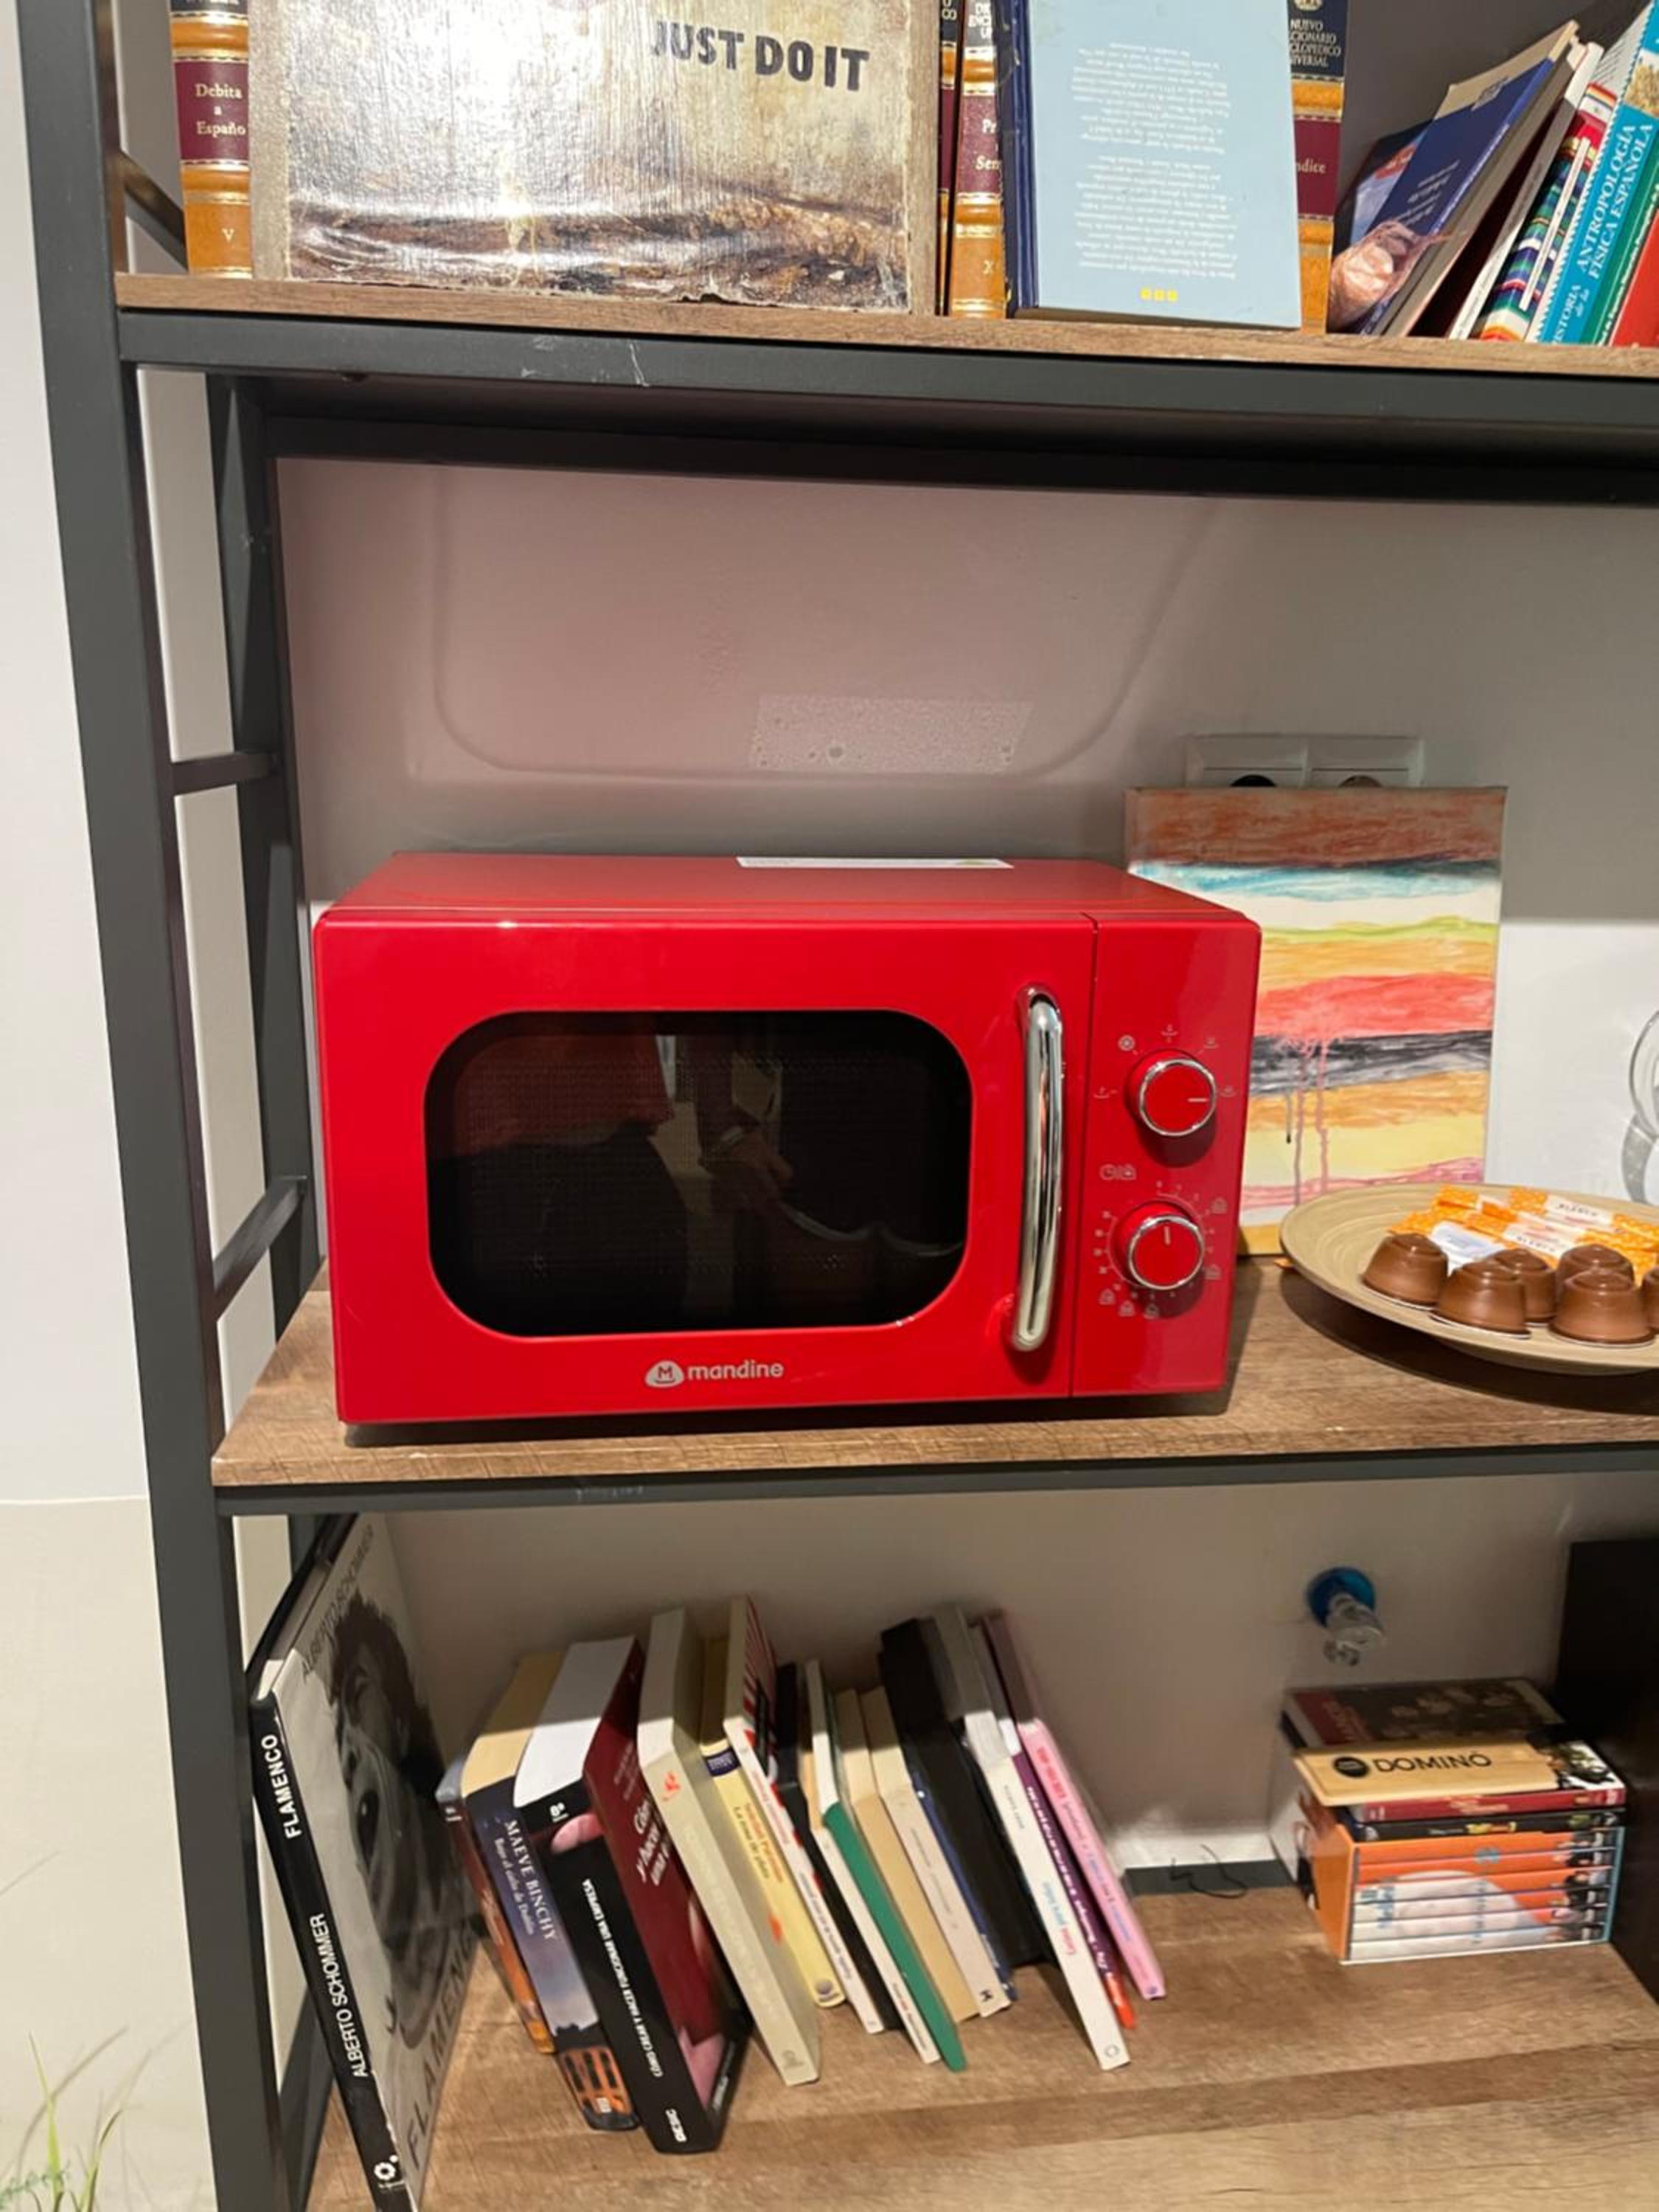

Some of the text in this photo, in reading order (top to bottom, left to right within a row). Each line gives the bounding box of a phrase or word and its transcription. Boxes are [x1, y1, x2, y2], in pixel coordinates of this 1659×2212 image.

[652, 21, 870, 91] JUST DO IT
[195, 83, 243, 100] Debita
[214, 105, 223, 116] a
[1576, 125, 1635, 273] ANTROPOLOGÍA
[1587, 220, 1618, 279] FÍSICA
[1610, 123, 1653, 219] ESPAÑOLA
[222, 228, 234, 243] V
[1553, 284, 1582, 345] ISTORIA
[687, 1359, 785, 1380] mandine
[261, 1733, 302, 1840] FLAMENCO
[504, 1820, 557, 1940] MAEVE BINCHY
[309, 1913, 369, 2078] ALBERTO SCHOMMER
